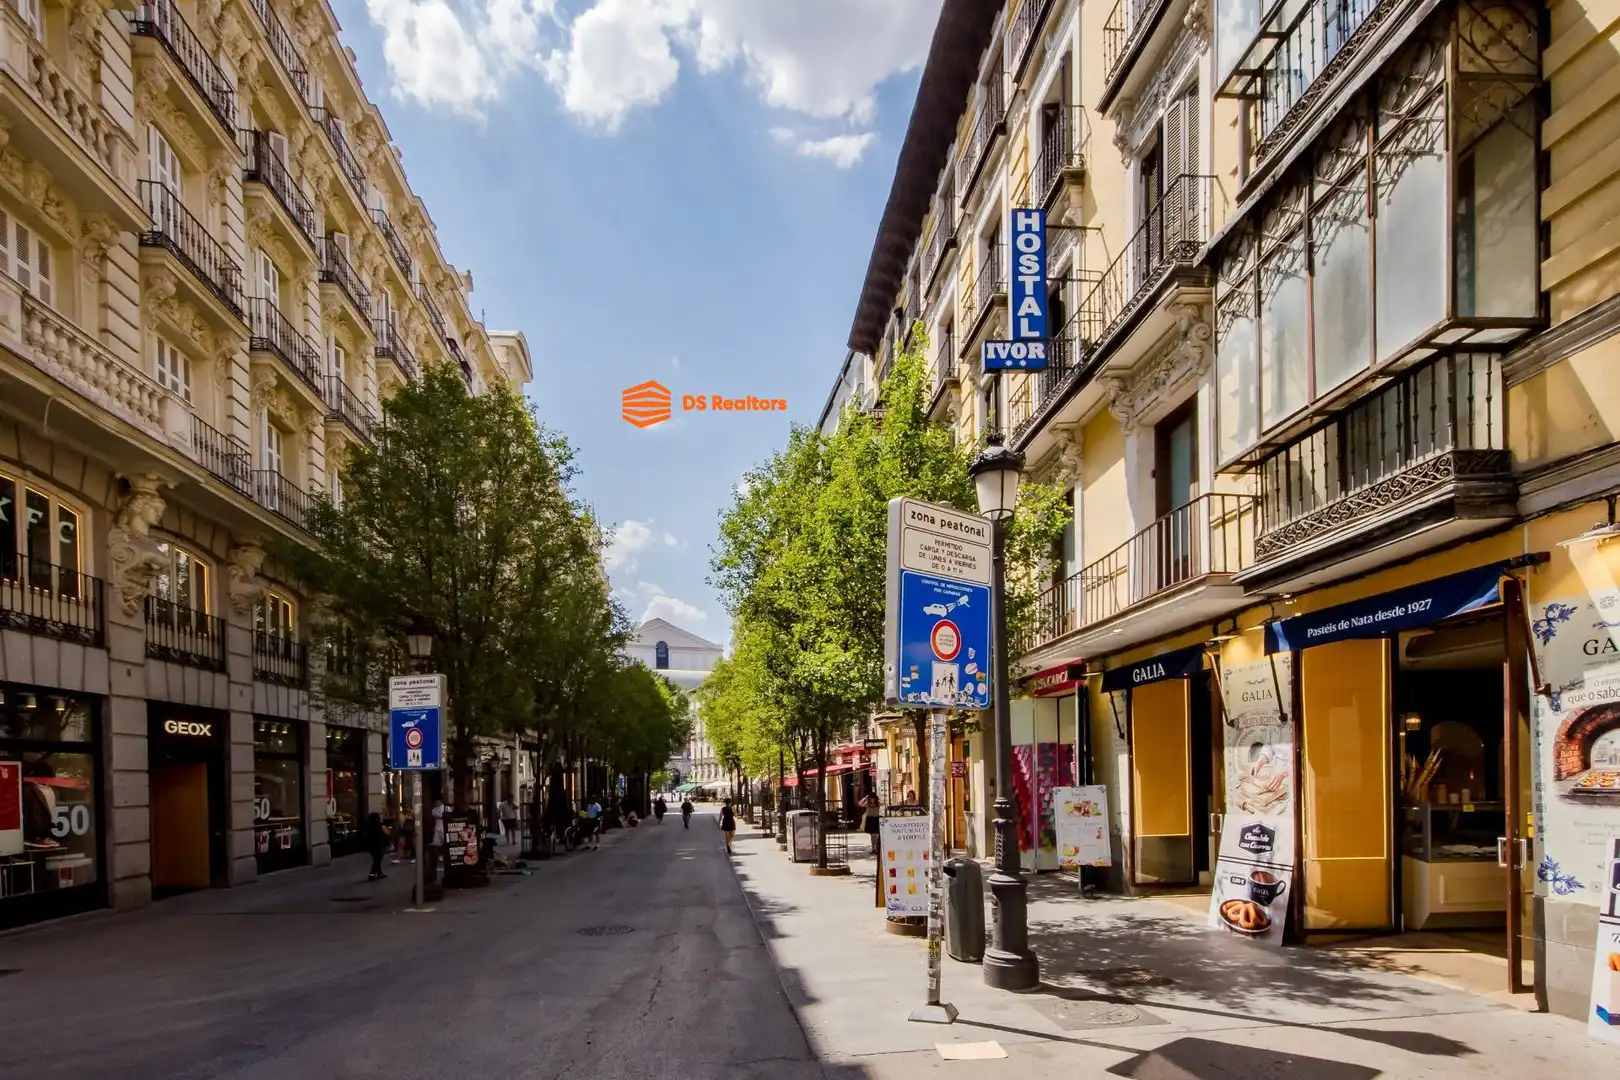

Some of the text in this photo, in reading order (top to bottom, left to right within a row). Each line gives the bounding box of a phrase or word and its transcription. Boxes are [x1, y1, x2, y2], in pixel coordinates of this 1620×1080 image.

[1016, 211, 1042, 338] HOSTAL
[986, 342, 1045, 360] IVOR
[911, 510, 985, 538] zona peatonal
[919, 544, 939, 554] CARGA
[947, 550, 977, 562] DESCARGA
[934, 540, 963, 551] PERMITIDO
[918, 551, 926, 559] DE
[928, 554, 946, 564] LUNES
[954, 559, 977, 570] VIERNES
[1307, 598, 1433, 638] Pastéis de Nata desde 1927
[1132, 663, 1166, 683] GALIA
[1241, 688, 1274, 703] GALIA
[1568, 692, 1586, 705] que
[1587, 690, 1595, 701] o
[165, 720, 211, 737] GEOX
[51, 805, 90, 838] 50
